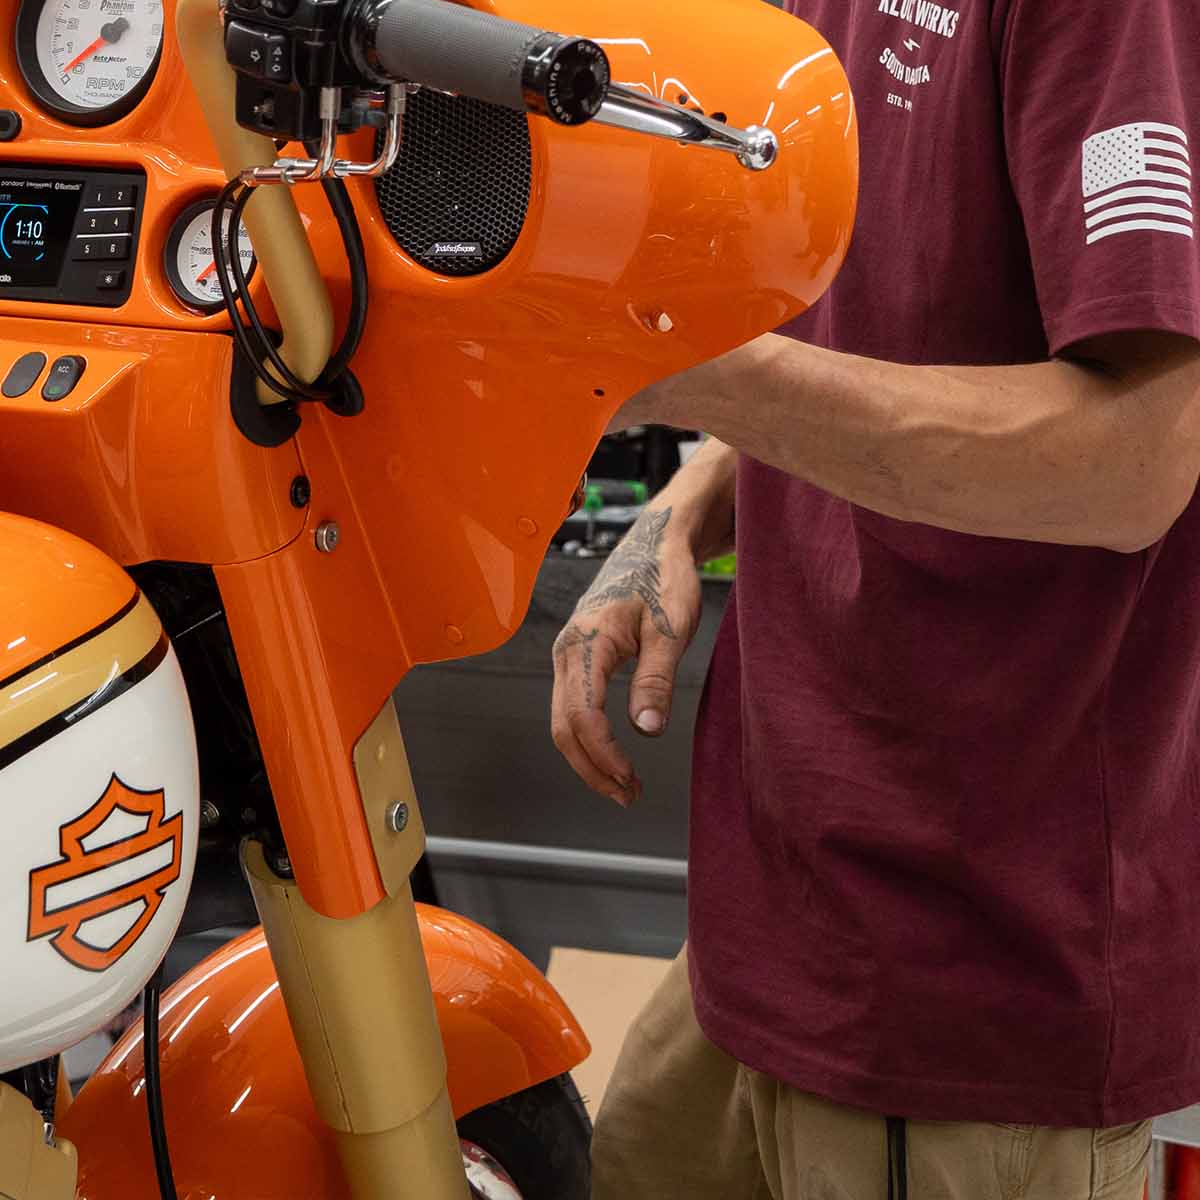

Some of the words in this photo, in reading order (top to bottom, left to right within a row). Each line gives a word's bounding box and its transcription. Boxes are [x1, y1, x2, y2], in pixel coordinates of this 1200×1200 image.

[86, 77, 125, 90] RPM
[117, 191, 123, 201] 2
[113, 217, 119, 227] 4
[15, 220, 43, 239] 1:10
[84, 244, 90, 254] 5
[110, 243, 116, 253] 6
